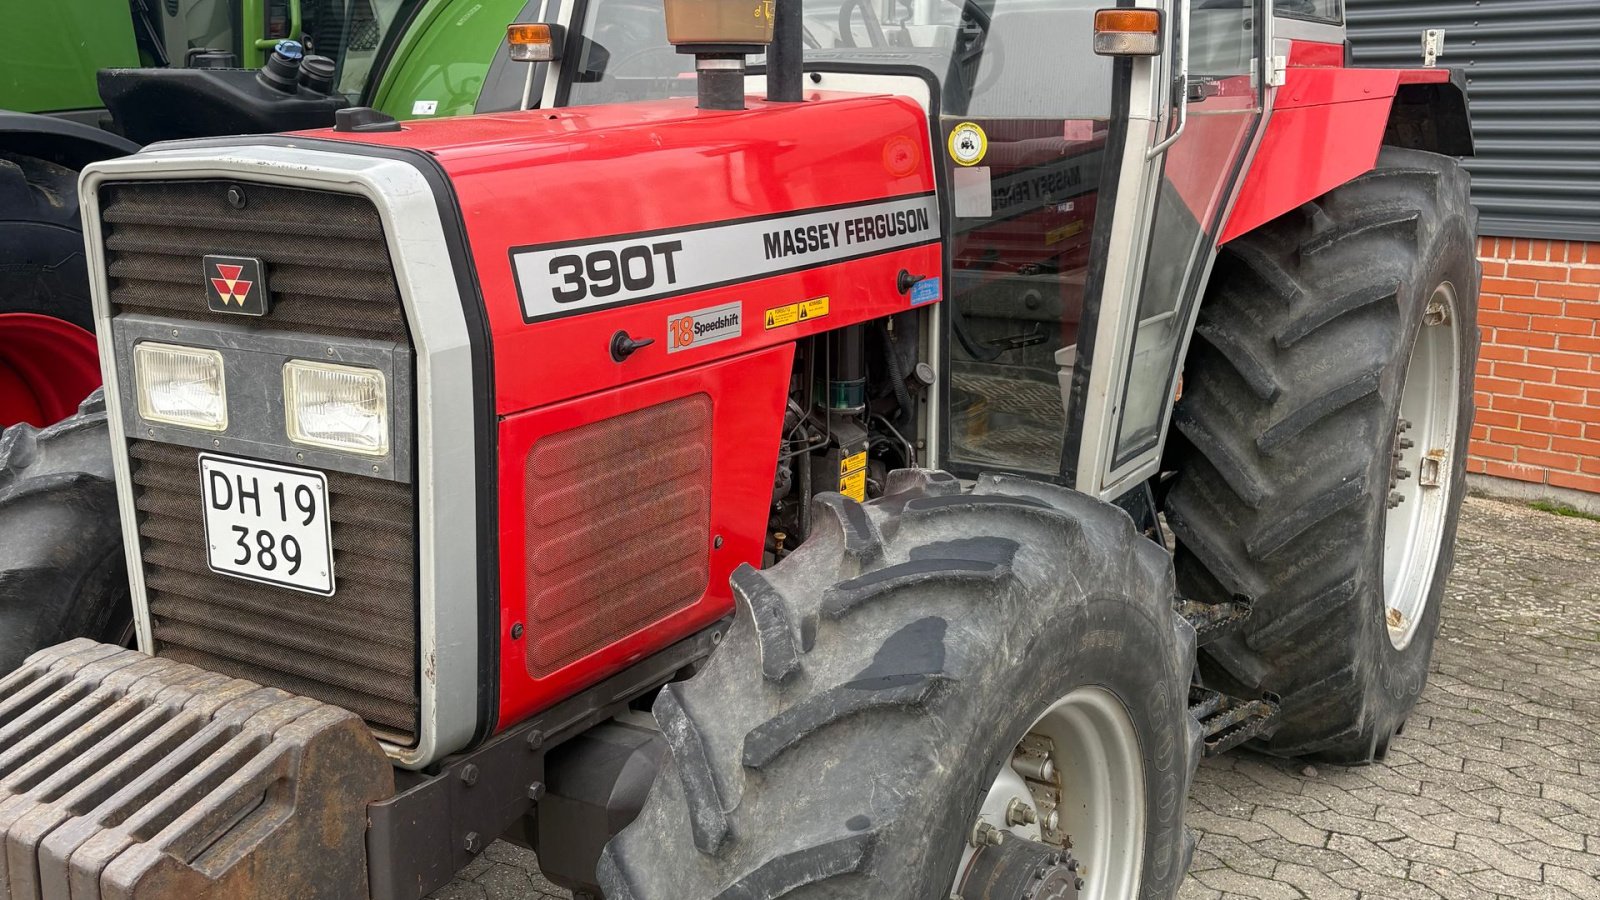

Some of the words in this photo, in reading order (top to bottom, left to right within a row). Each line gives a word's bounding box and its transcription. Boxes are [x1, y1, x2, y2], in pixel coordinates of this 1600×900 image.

[763, 222, 839, 260] MASSEY
[844, 207, 929, 245] FERGUSON
[549, 239, 682, 303] 390T
[670, 315, 694, 348] 18
[694, 313, 739, 336] Speedshift
[209, 469, 261, 517] DH
[274, 481, 316, 526] 19
[231, 524, 302, 575] 389
